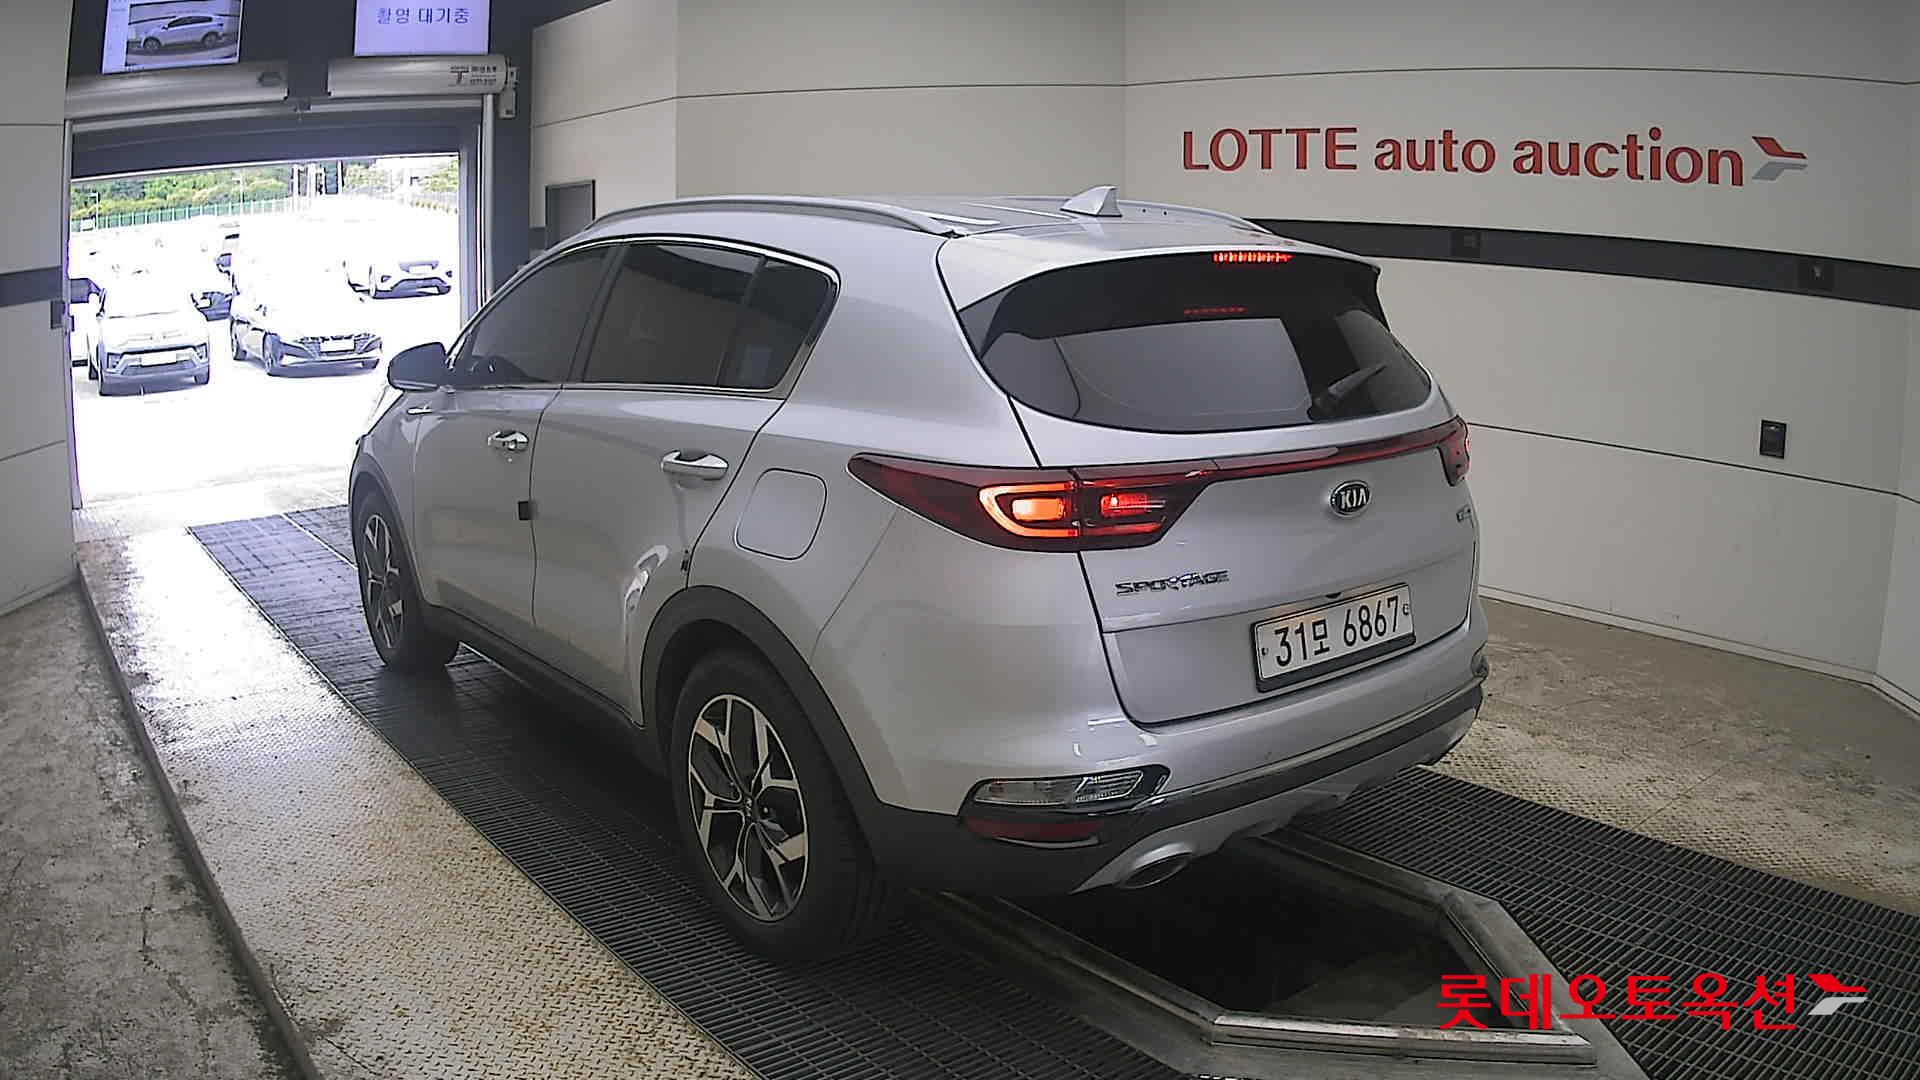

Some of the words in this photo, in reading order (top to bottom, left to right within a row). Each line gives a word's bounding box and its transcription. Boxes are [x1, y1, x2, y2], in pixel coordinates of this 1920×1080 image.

[418, 7, 471, 25] 대기중
[1182, 127, 1358, 171] LOTTE
[1374, 128, 1496, 173] auto
[1513, 127, 1744, 187] auction
[1340, 487, 1367, 509] KIA
[1115, 569, 1229, 596] SPORTAGE
[1343, 595, 1399, 647] 6867
